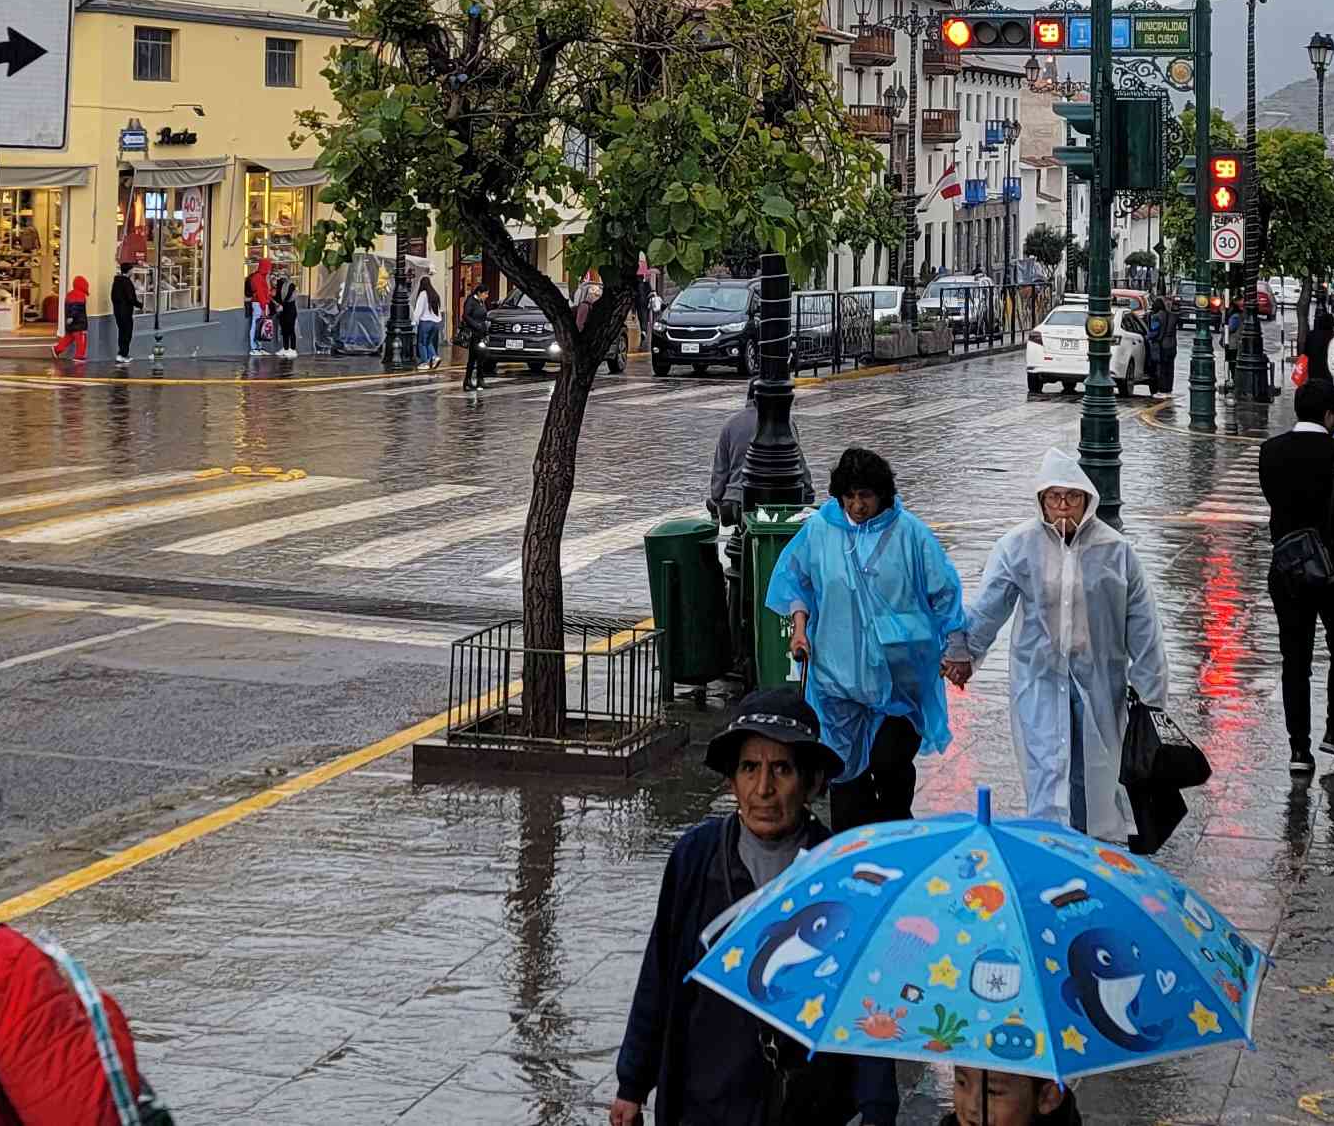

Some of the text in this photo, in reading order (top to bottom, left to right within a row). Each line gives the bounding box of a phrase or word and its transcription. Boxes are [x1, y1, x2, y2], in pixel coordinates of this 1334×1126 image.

[1136, 21, 1188, 31] MUNICIPALIDAD
[1144, 34, 1179, 44] DEL CUSCO
[153, 127, 197, 146] Bata
[1218, 237, 1237, 250] 30
